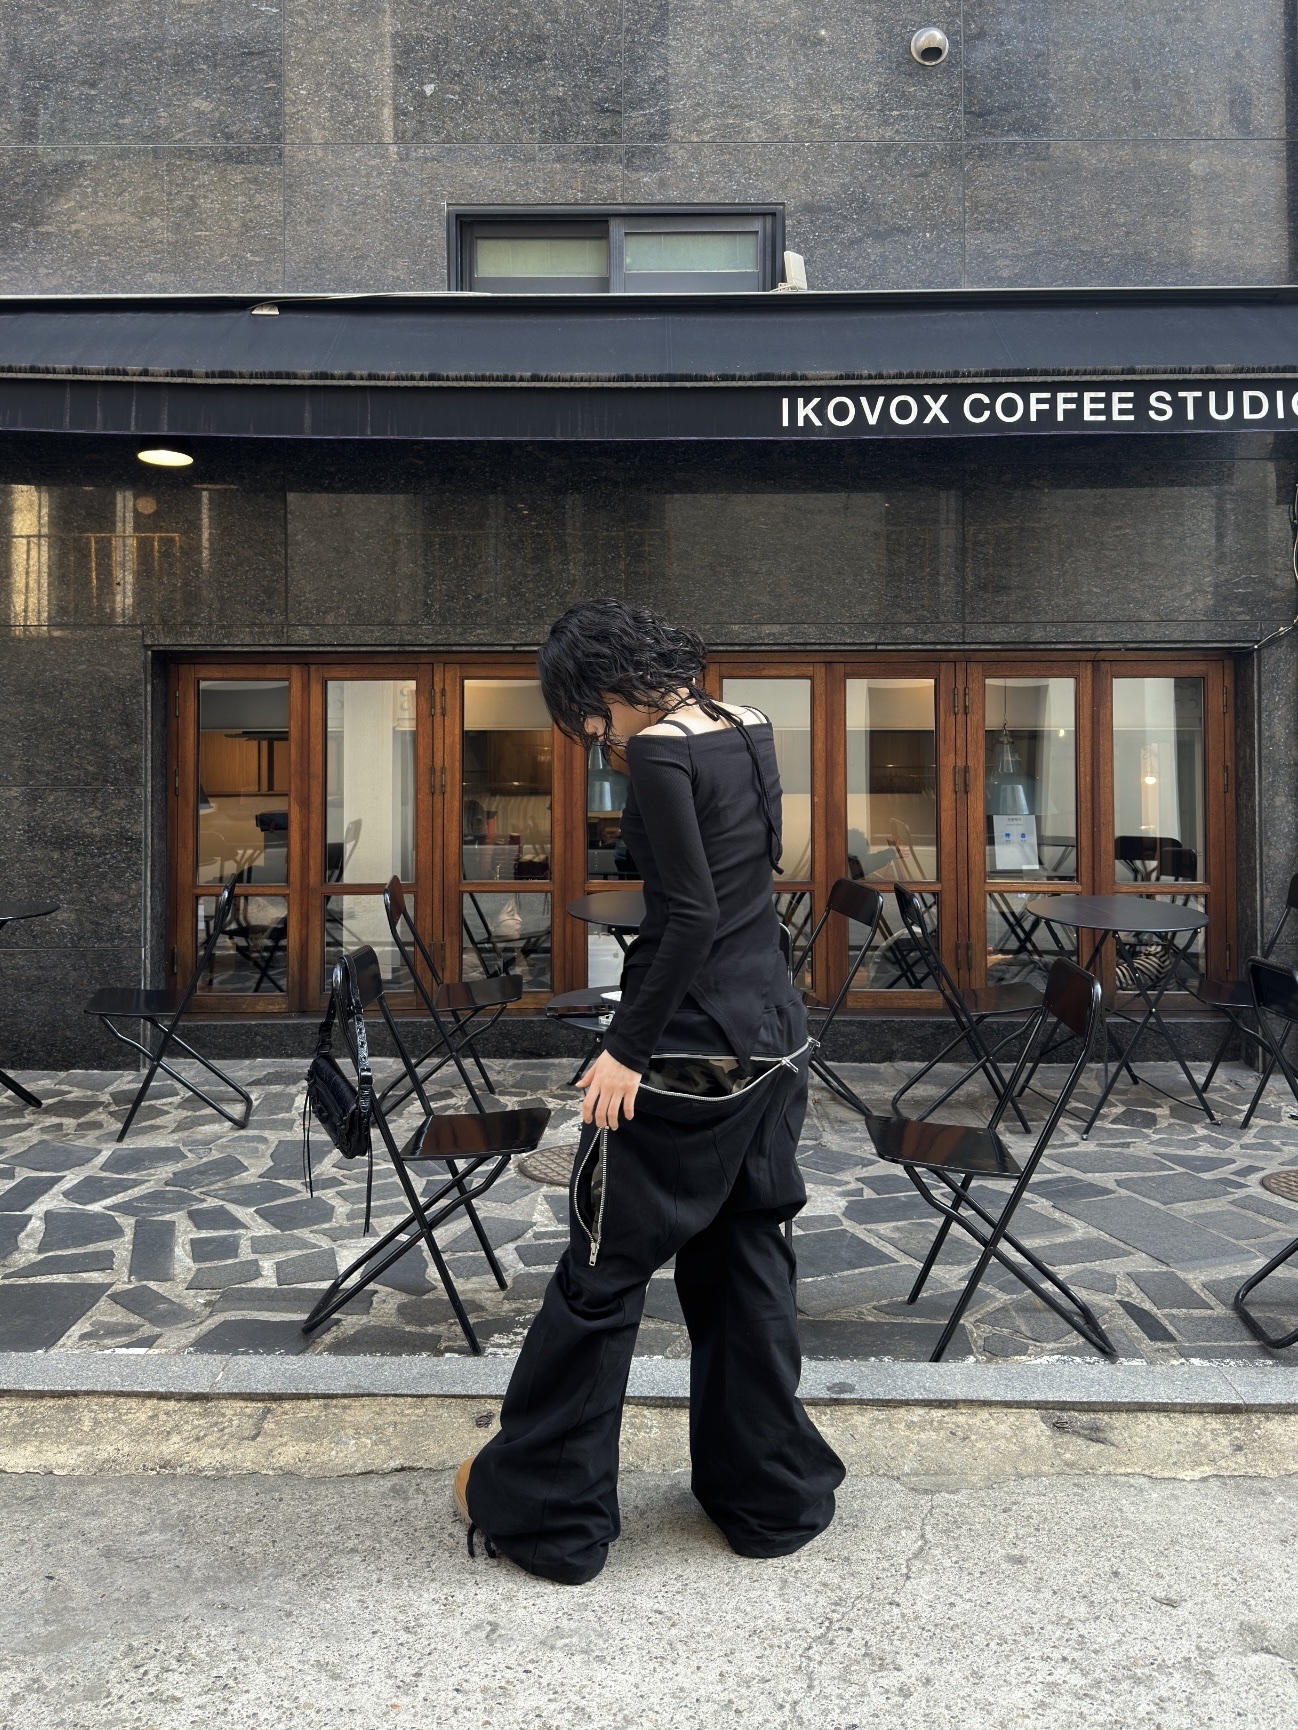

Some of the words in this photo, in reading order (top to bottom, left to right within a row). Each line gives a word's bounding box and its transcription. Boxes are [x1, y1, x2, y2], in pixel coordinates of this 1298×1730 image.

[782, 394, 950, 427] IKOVOX
[963, 391, 1135, 423] COFFEE
[1148, 390, 1298, 421] STUDI
